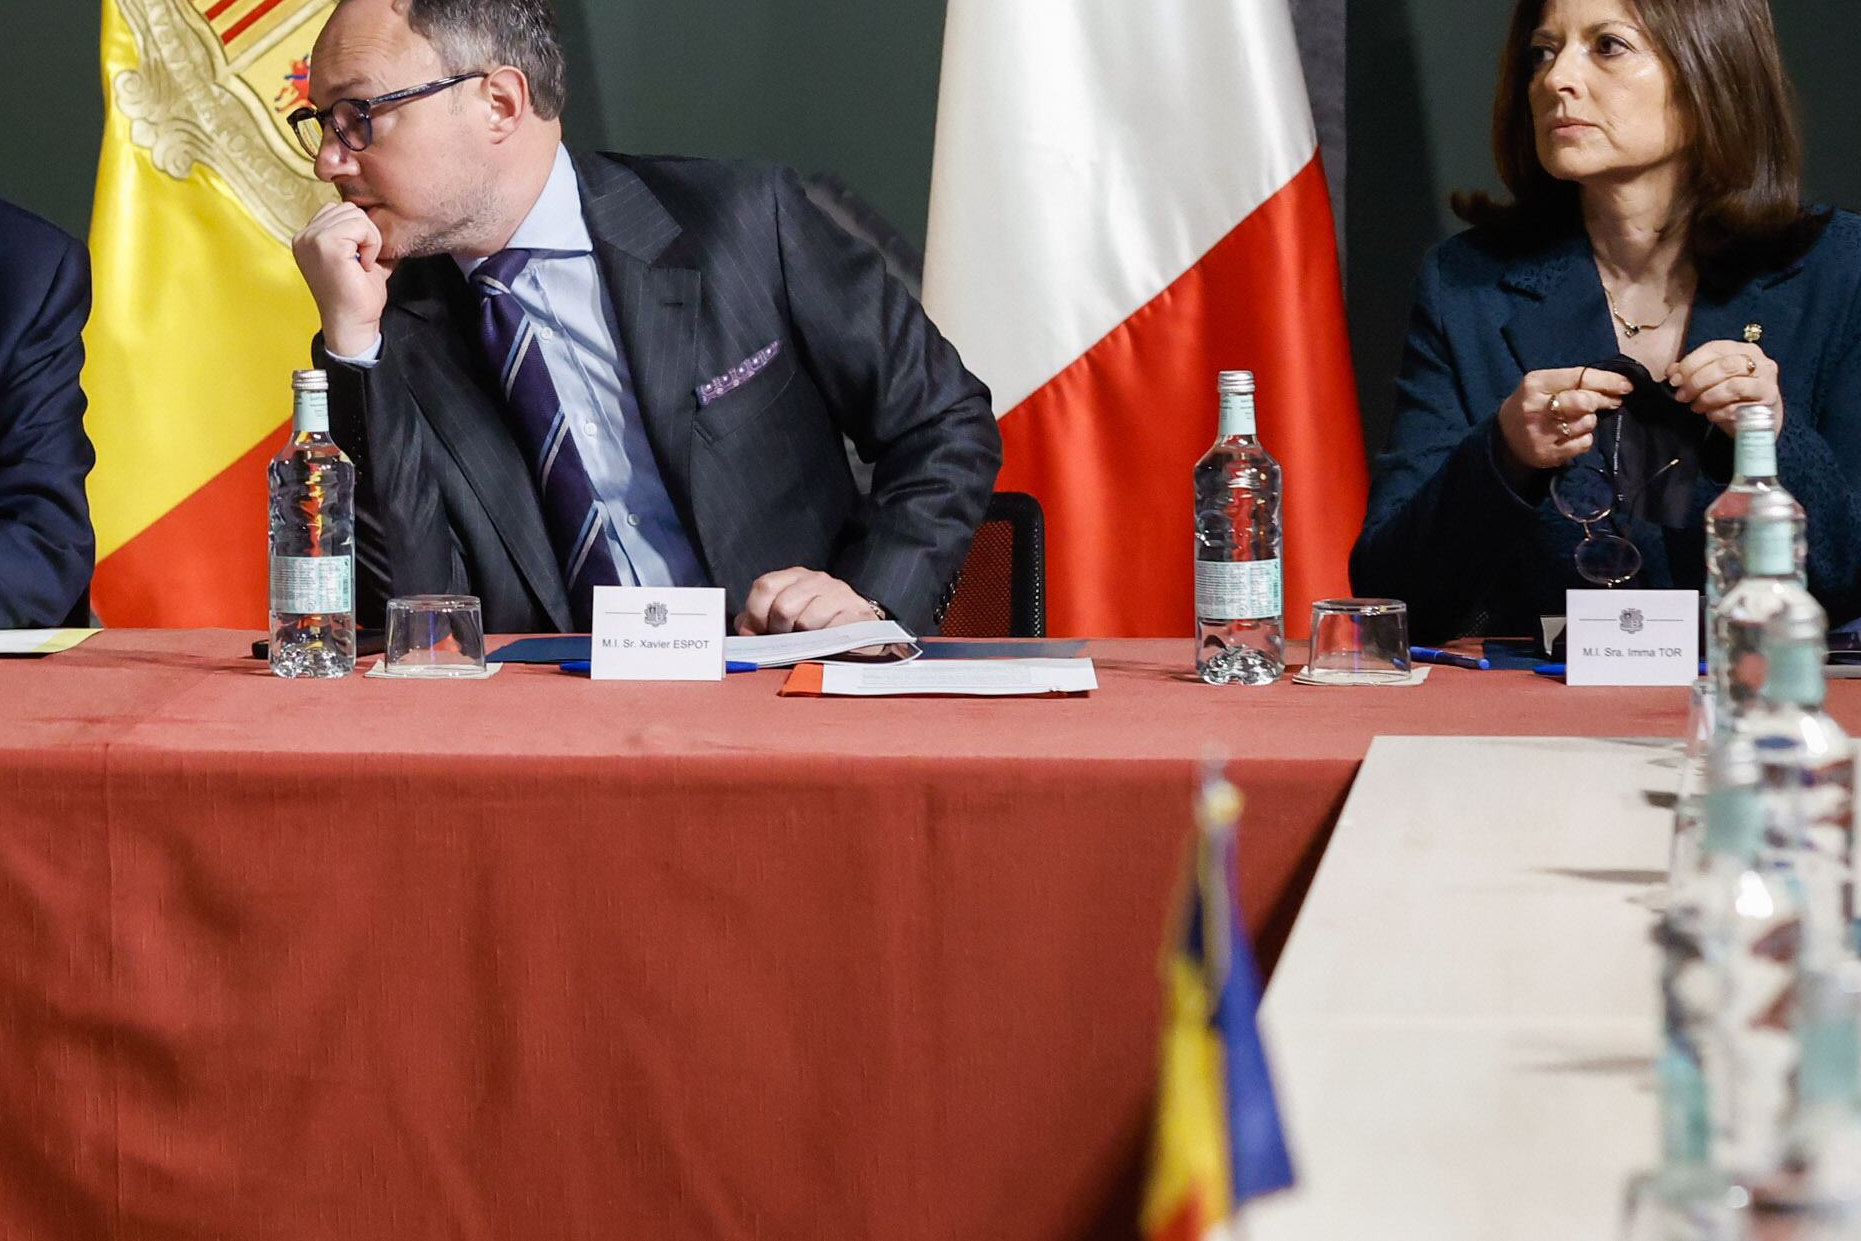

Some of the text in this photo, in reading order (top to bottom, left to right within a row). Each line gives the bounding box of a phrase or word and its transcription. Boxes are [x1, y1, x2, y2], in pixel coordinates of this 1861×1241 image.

[601, 638, 711, 650] M.I. Sr. Xavier ESPOT
[1603, 647, 1624, 658] Sra.
[1627, 647, 1657, 658] Imma
[1658, 647, 1683, 658] TOR
